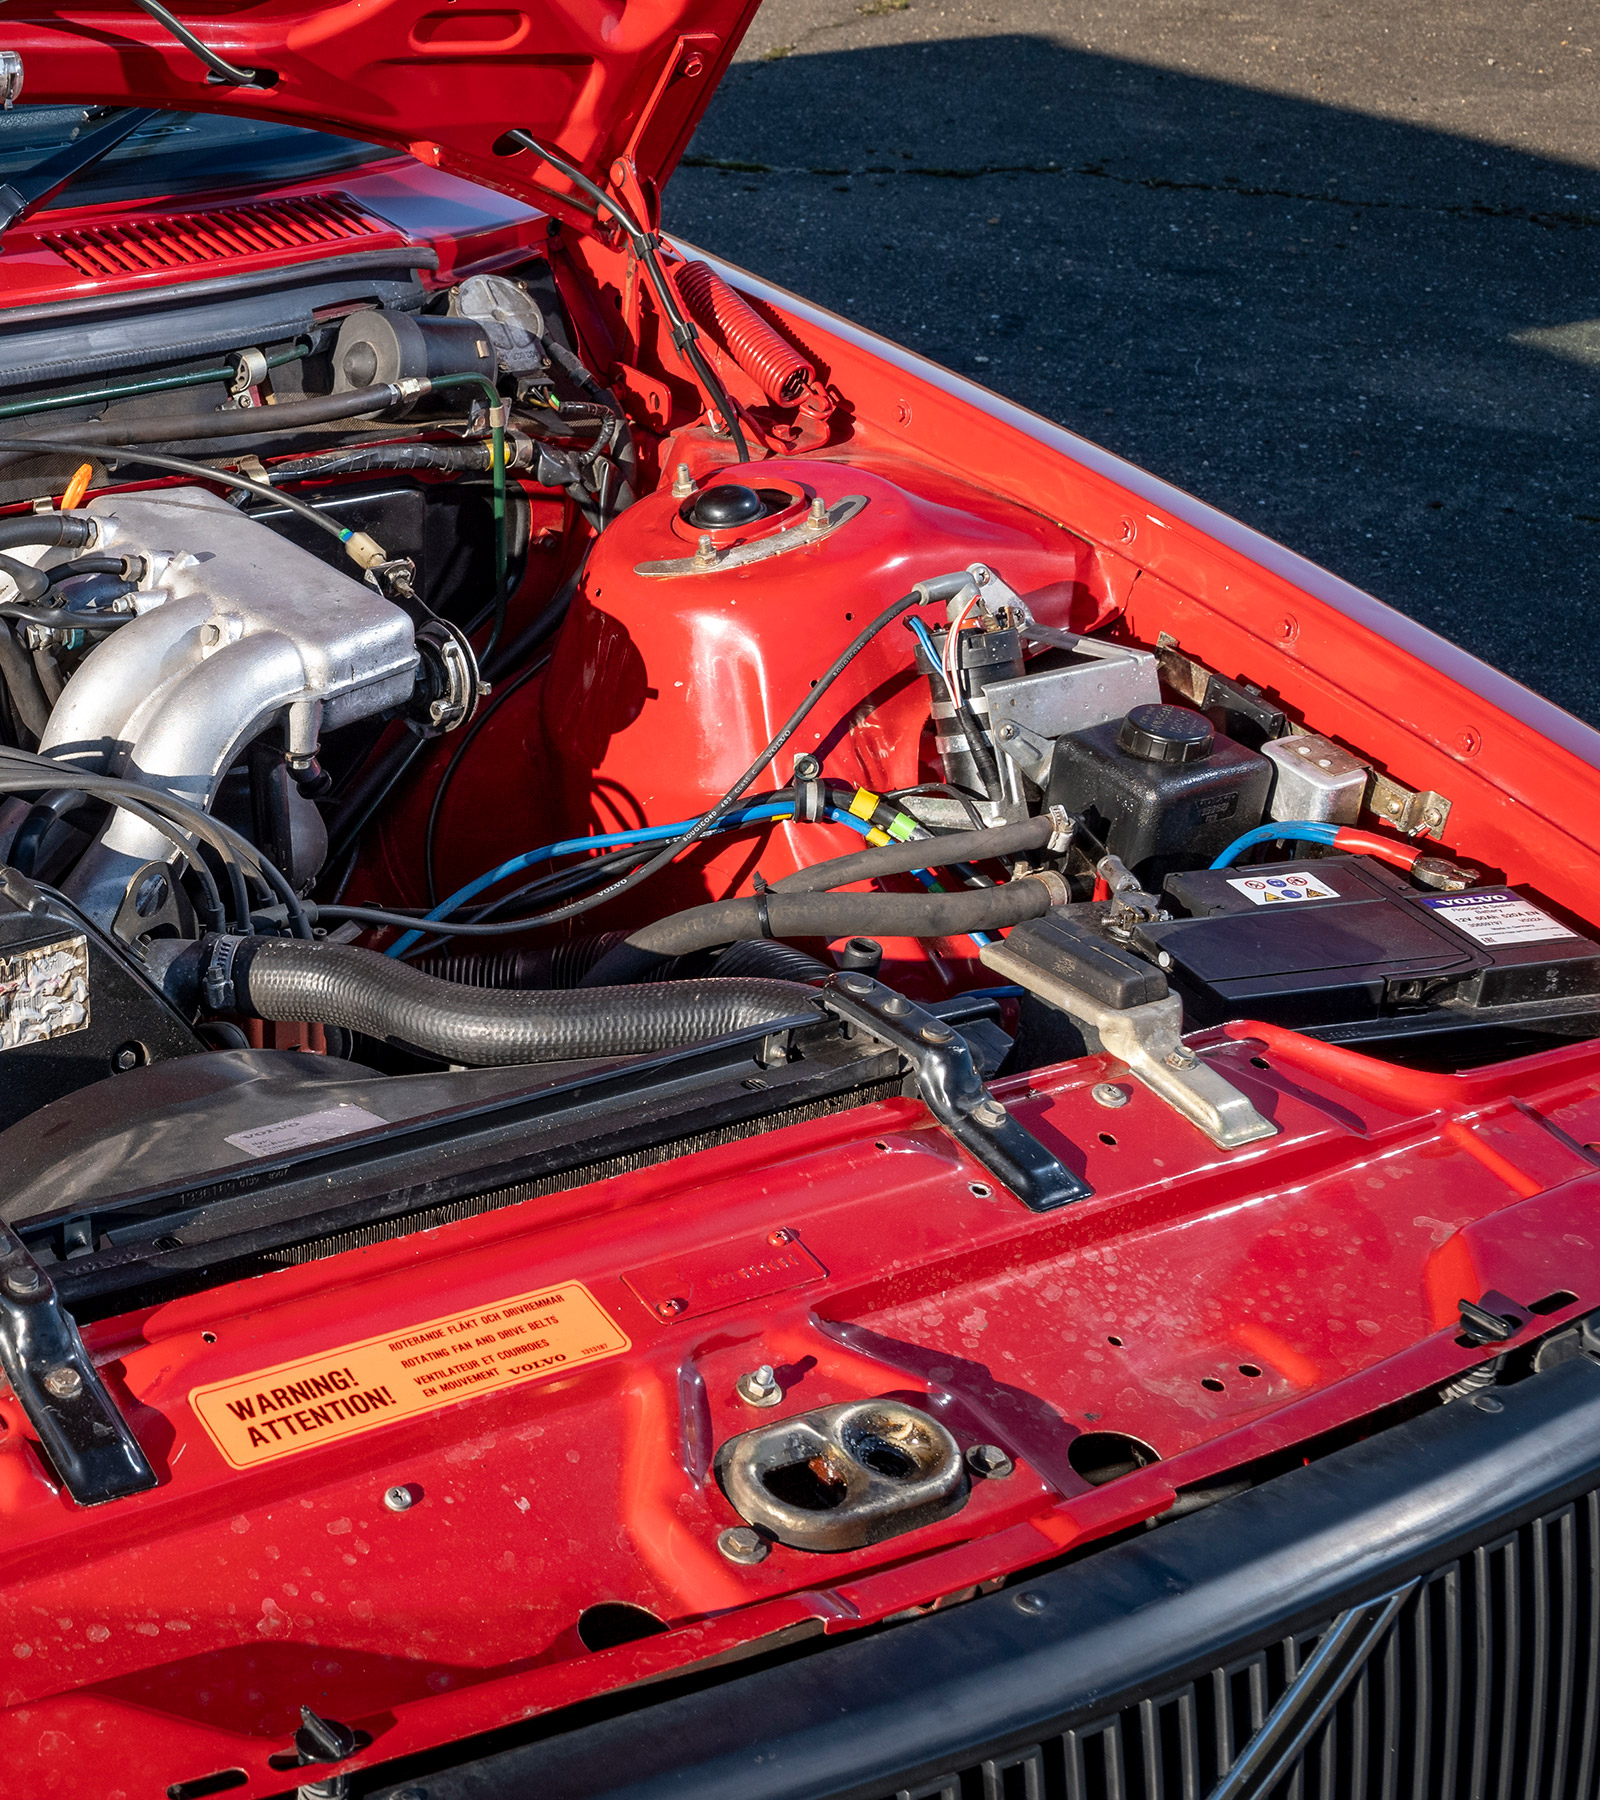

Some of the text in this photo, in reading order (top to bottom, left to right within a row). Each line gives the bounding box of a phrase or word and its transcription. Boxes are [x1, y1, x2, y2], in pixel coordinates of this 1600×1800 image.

[682, 809, 717, 842] BOUGICORD
[720, 796, 733, 808] 403
[734, 776, 751, 794] CLASS
[765, 729, 791, 758] VOLVO
[596, 878, 629, 898] VOLVO
[1435, 894, 1509, 907] VOLVO
[240, 1121, 301, 1140] VOLVO
[388, 1294, 565, 1352] ROTERANDE FLÄKT OCH DRIVREMMAR
[400, 1315, 560, 1370] ROTATING FAN AND DRIVE BELTS
[413, 1338, 551, 1387] VENTILATEUR ET COURROIES
[422, 1367, 501, 1398] EN MOUVEMENT
[506, 1353, 568, 1376] VOLVO
[225, 1367, 360, 1422] WARNING!
[246, 1385, 397, 1449] ATTENTION!
